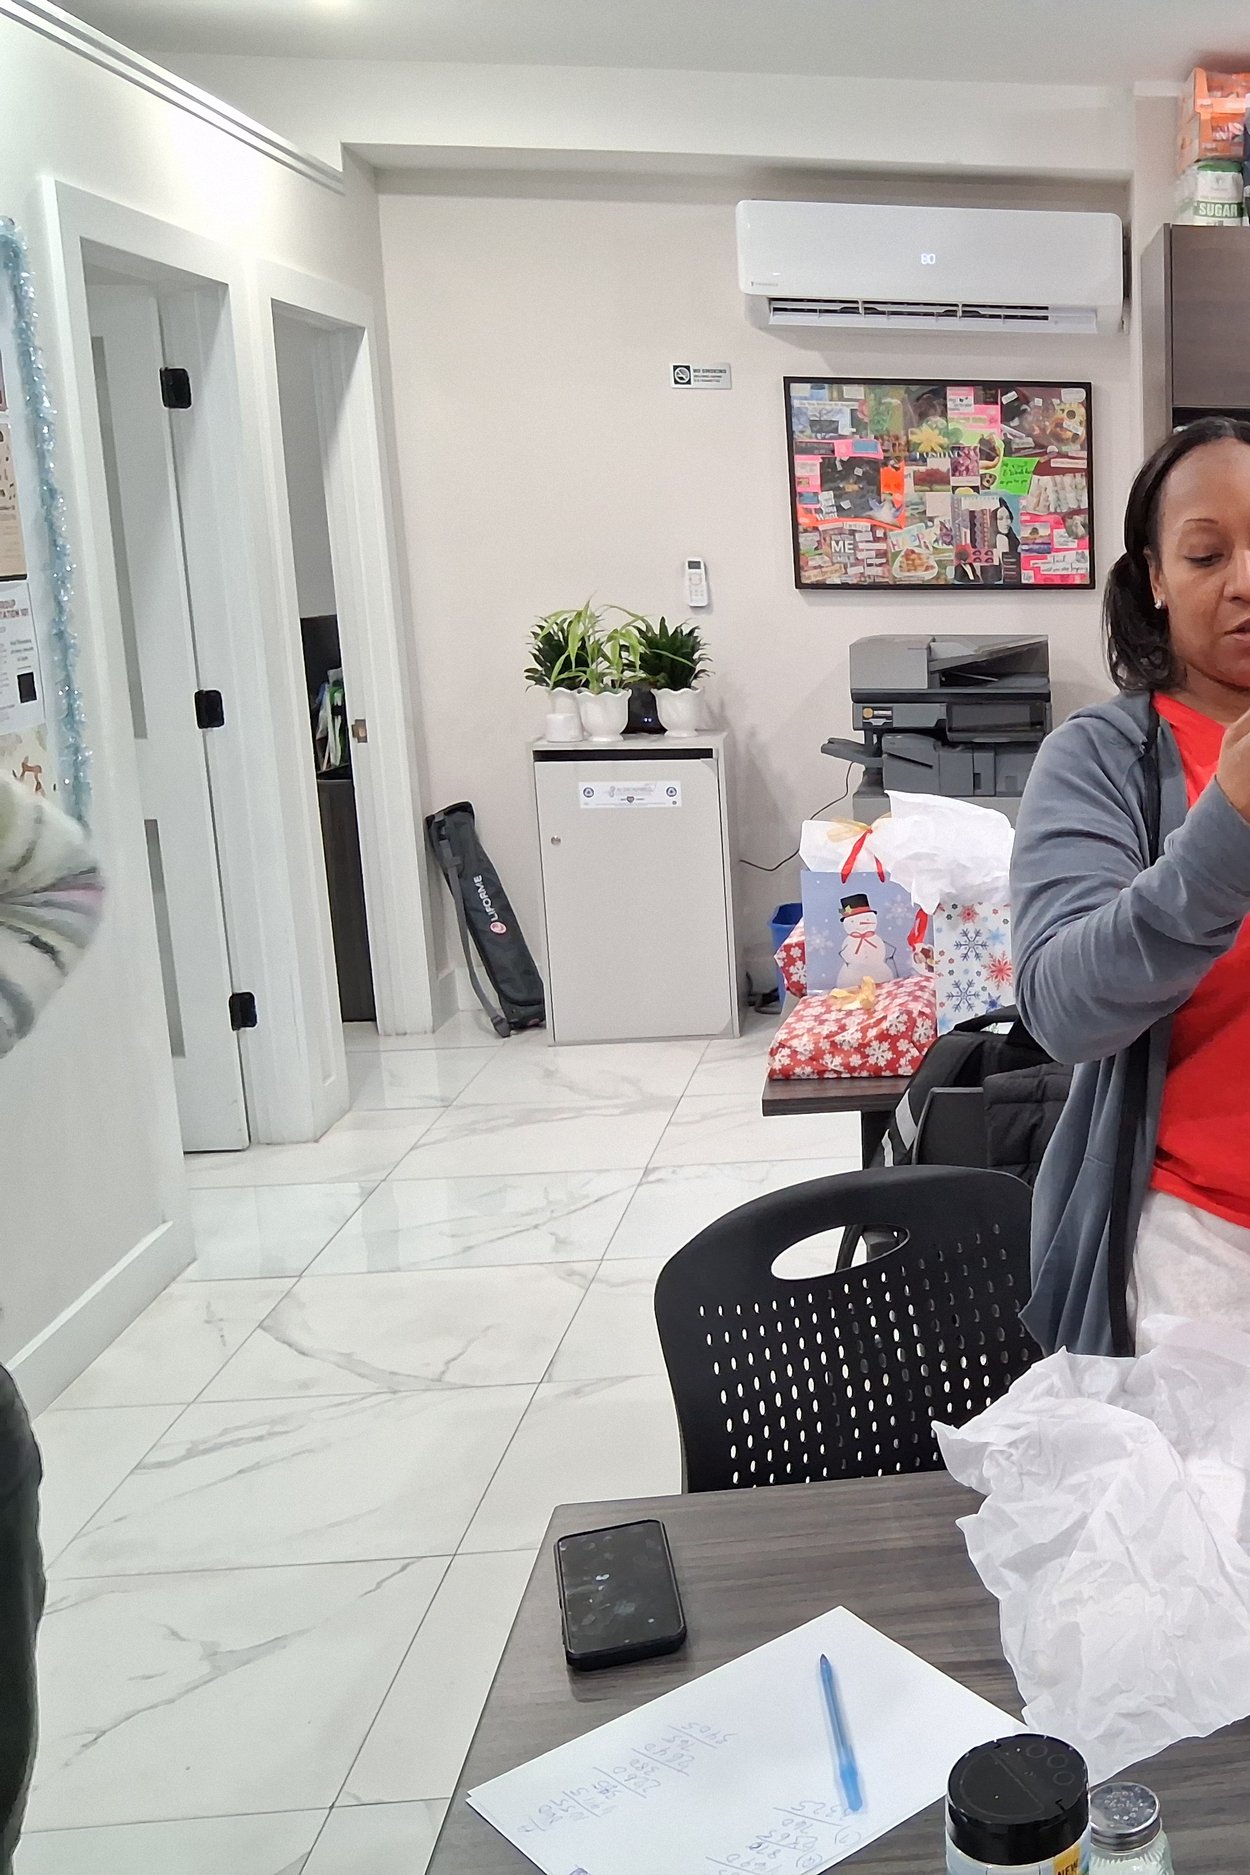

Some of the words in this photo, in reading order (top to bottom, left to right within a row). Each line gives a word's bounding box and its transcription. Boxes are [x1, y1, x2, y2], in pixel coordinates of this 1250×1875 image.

[1199, 203, 1238, 217] SUGAR
[831, 540, 854, 554] ME
[473, 875, 499, 921] LIFORME
